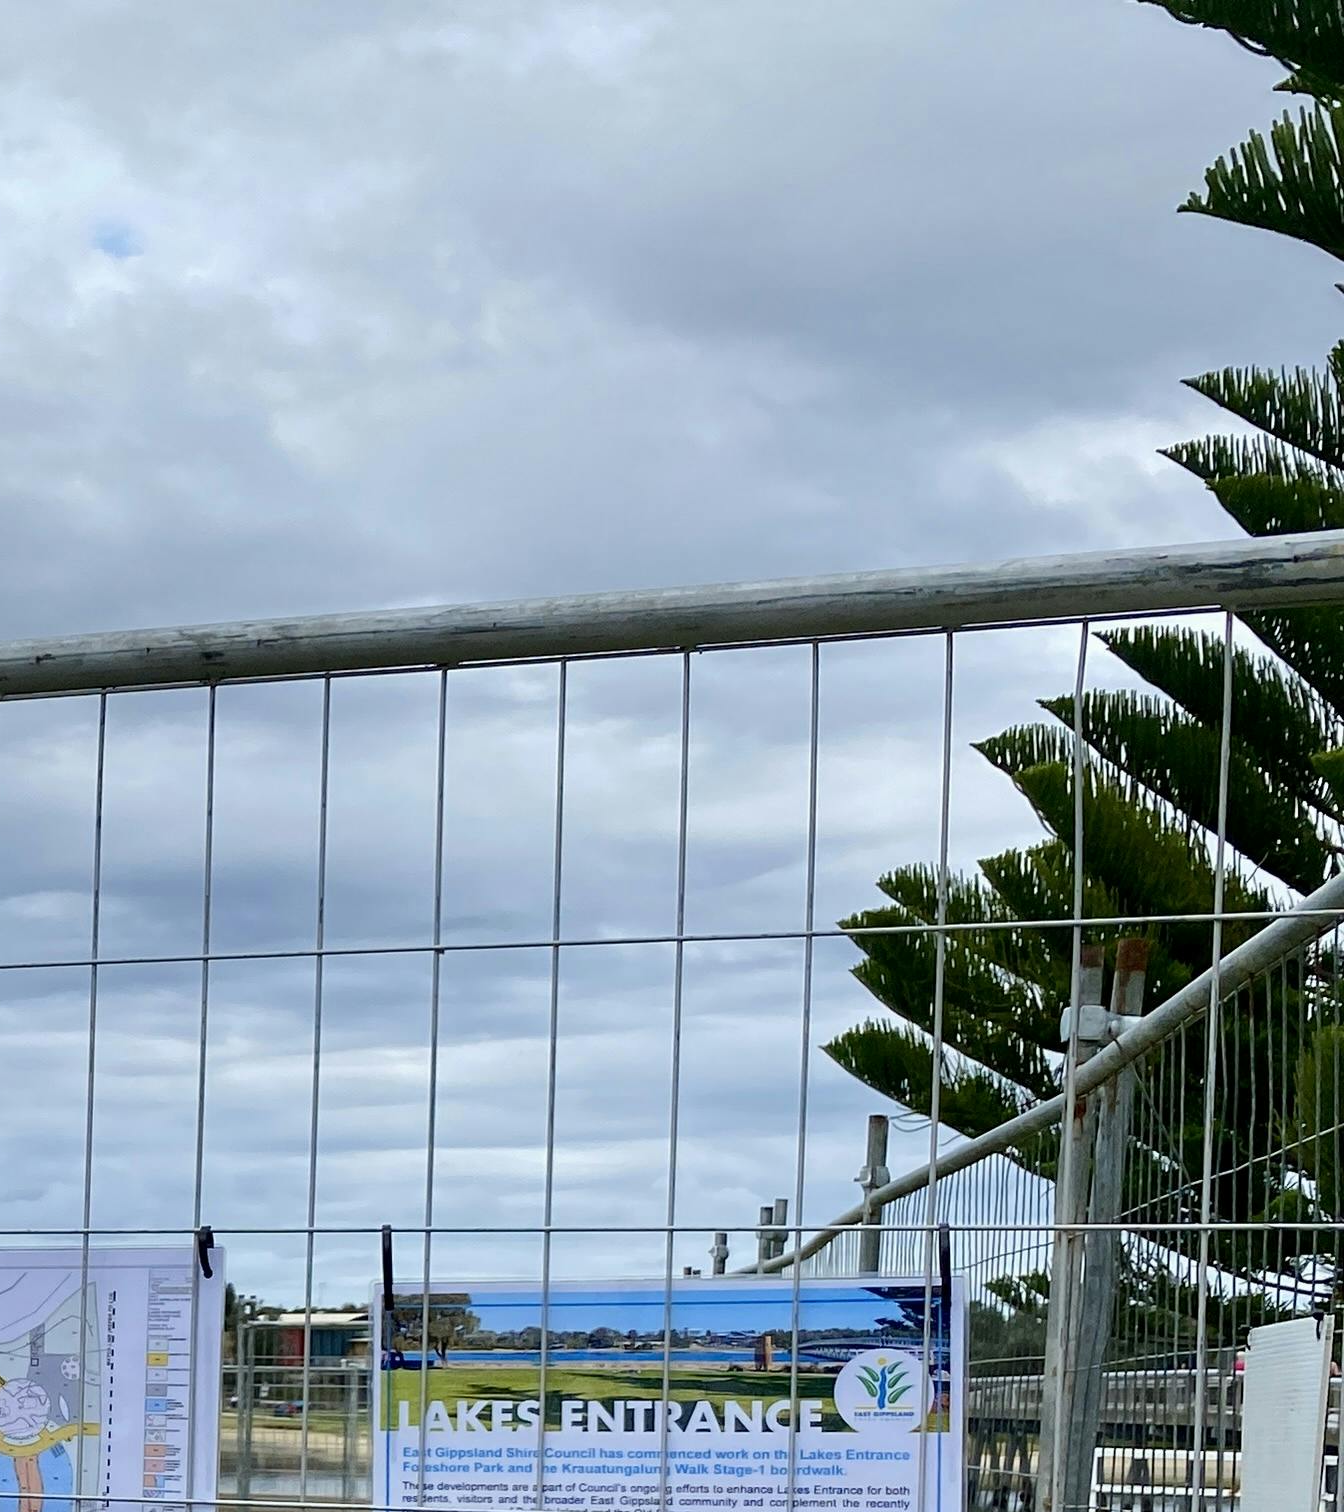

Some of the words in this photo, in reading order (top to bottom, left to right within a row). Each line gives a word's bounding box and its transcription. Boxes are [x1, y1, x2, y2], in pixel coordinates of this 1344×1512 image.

[399, 1400, 540, 1433] LAKES
[562, 1399, 823, 1433] ENTRANCE
[402, 1447, 431, 1457] Eat
[435, 1447, 502, 1460] Gippsland
[544, 1447, 595, 1458] Council
[599, 1448, 623, 1458] has
[714, 1448, 749, 1459] work
[752, 1451, 770, 1459] on
[799, 1448, 841, 1459] Lakes
[845, 1449, 910, 1460] Entrance
[402, 1461, 470, 1472] Foeshore
[474, 1462, 503, 1472] Park
[507, 1462, 532, 1472] and
[674, 1463, 709, 1474] Walk
[713, 1463, 764, 1477] Stage-1
[770, 1463, 846, 1475] bordwalk.
[436, 1481, 509, 1493] developments
[542, 1482, 562, 1494] part
[565, 1482, 576, 1492] of
[578, 1482, 627, 1492] Council's
[675, 1483, 709, 1493] efforts
[712, 1483, 723, 1493] to
[726, 1484, 773, 1494] enhance
[813, 1484, 863, 1495] Entrance
[866, 1485, 881, 1495] for
[884, 1485, 910, 1495] both
[456, 1494, 493, 1503] visitors
[497, 1494, 518, 1503] and
[543, 1495, 585, 1504] broader
[590, 1495, 615, 1504] East
[678, 1496, 738, 1508] community
[742, 1497, 764, 1506] and
[841, 1498, 860, 1507] the
[865, 1498, 911, 1510] recently
